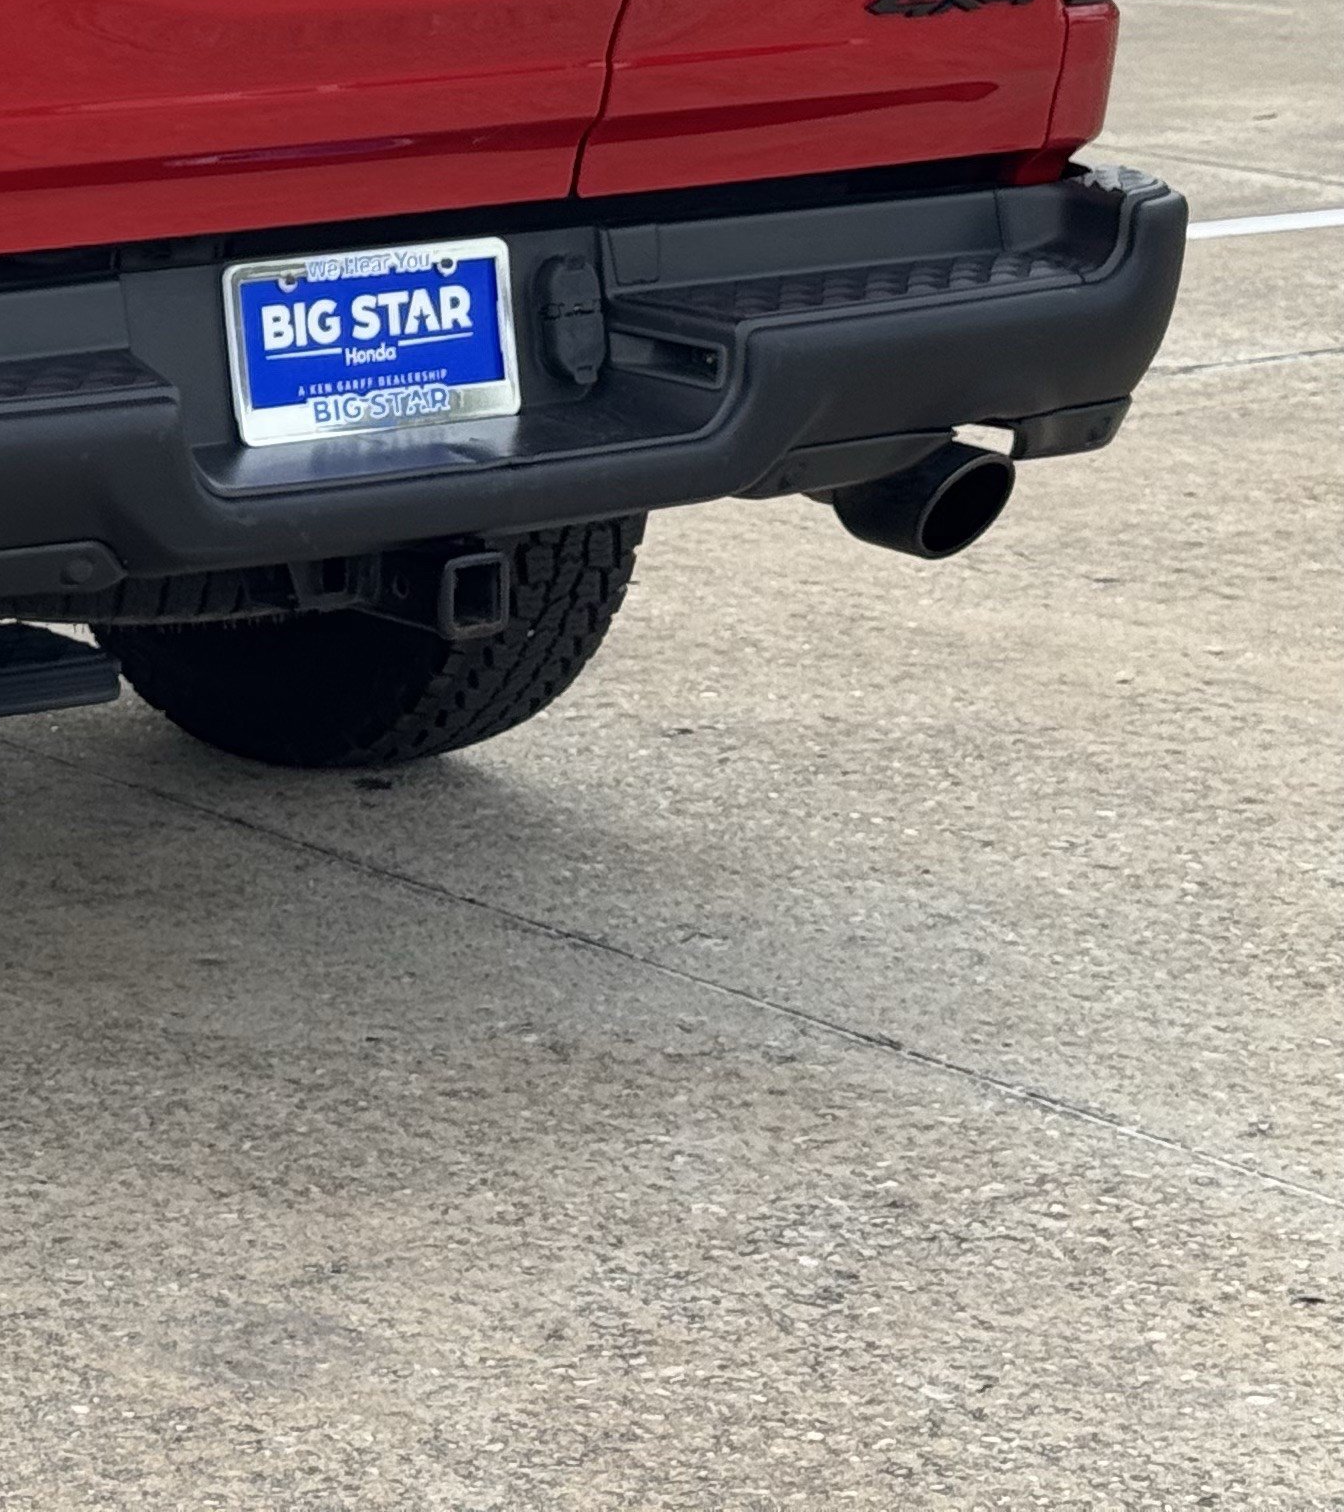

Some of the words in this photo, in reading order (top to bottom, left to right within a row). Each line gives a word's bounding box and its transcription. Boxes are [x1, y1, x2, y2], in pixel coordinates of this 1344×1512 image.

[306, 259, 339, 279] We
[394, 251, 430, 270] You
[261, 299, 341, 350] BIG
[352, 286, 474, 341] STAR
[345, 342, 397, 366] Honda
[298, 385, 306, 397] A
[378, 368, 448, 387] DEALERSHIP
[313, 395, 362, 423] BIG
[370, 386, 450, 418] STAR
